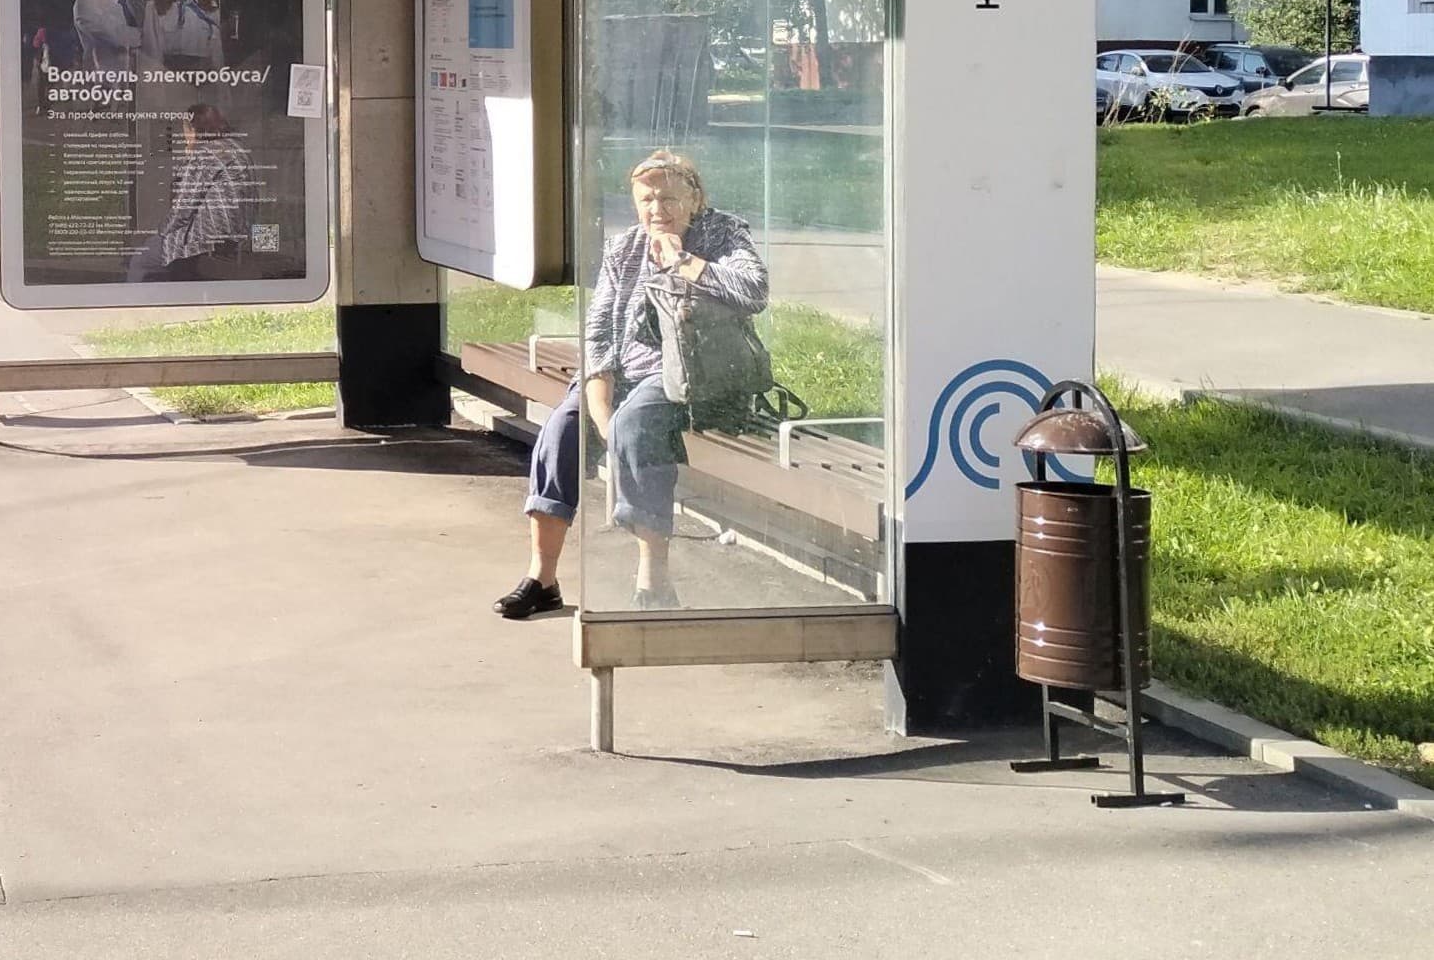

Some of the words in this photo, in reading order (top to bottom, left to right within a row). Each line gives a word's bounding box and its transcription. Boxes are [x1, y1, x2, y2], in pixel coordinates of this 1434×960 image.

[48, 66, 138, 85] Водитель
[143, 65, 269, 86] электробуса/
[48, 85, 133, 105] автобуса
[47, 110, 66, 120] Эта
[68, 109, 123, 121] профессия
[126, 110, 158, 121] нужна
[160, 110, 194, 121] городу
